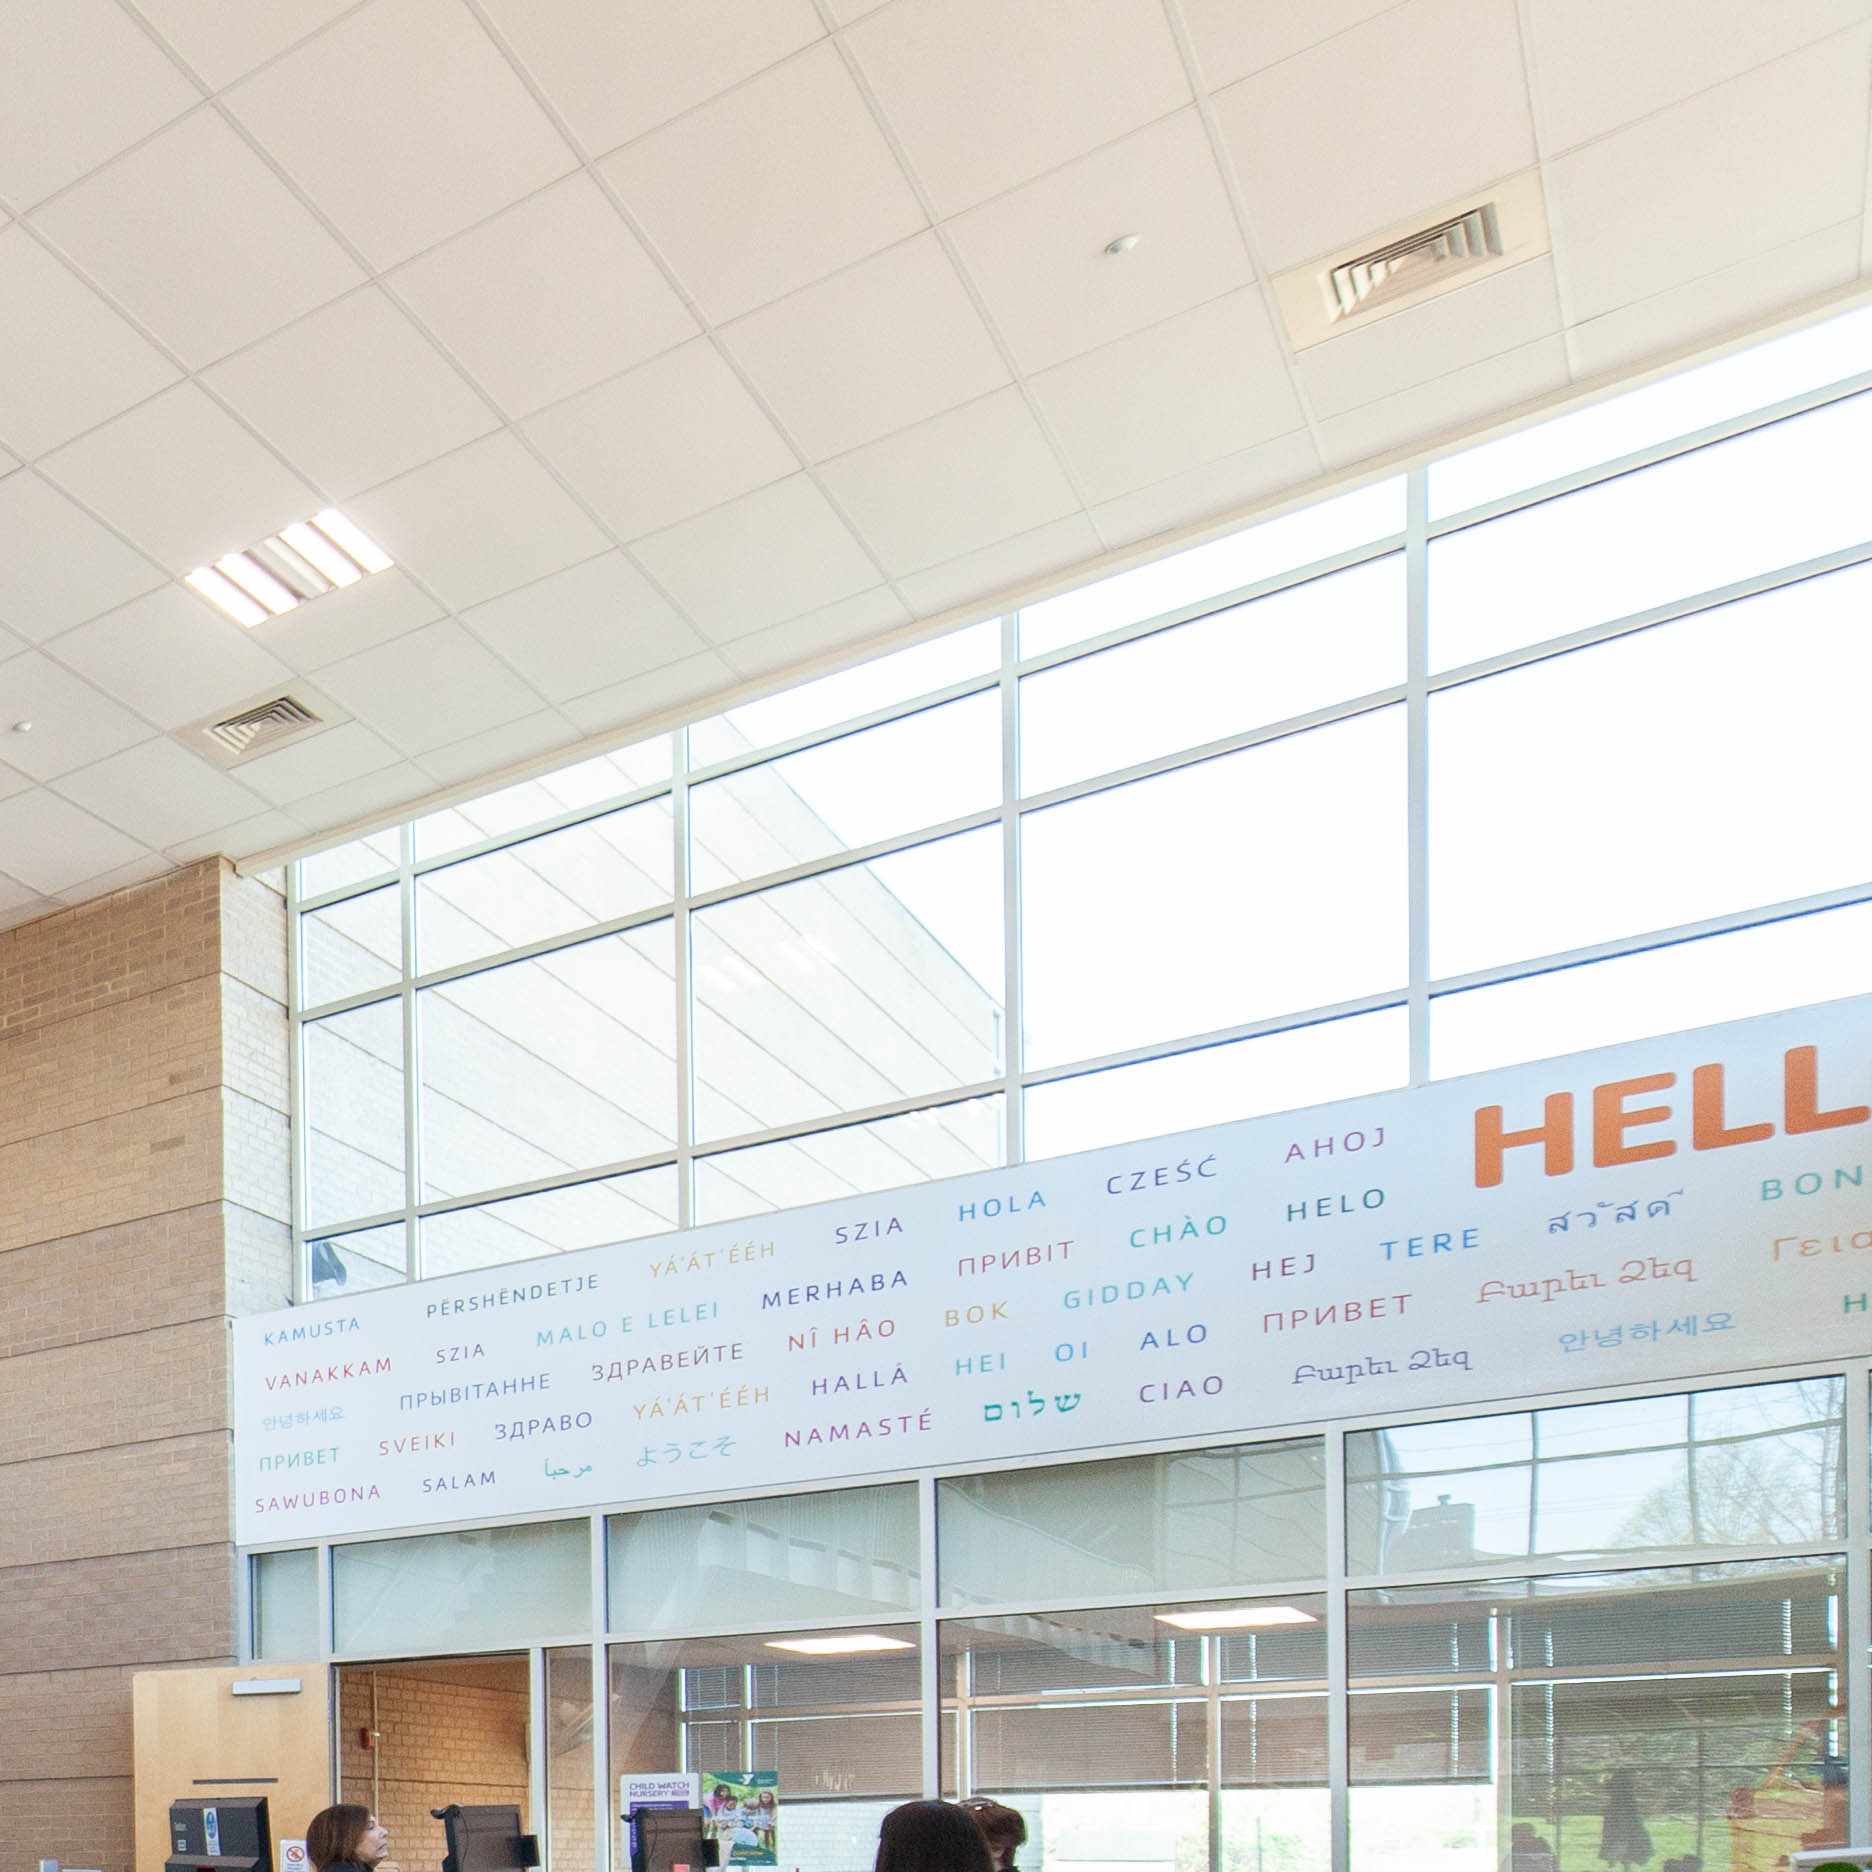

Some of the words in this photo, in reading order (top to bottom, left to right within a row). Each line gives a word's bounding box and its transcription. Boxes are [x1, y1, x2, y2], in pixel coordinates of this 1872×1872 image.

[1473, 1044, 1871, 1189] HELL
[1285, 1127, 1384, 1163] AHOJ
[1107, 1155, 1216, 1195] CZEŚĆ
[1762, 1165, 1863, 1201] BON
[959, 1191, 1045, 1222] HOLA
[1288, 1189, 1384, 1222] HELO
[835, 1217, 903, 1244] SZIA
[1130, 1215, 1227, 1248] CHÀO
[1379, 1228, 1478, 1260] TERE
[958, 1241, 1074, 1276] ПРИВІТ
[1252, 1254, 1314, 1281] HEJ
[426, 1273, 600, 1319] PËRSHËNDETJE
[762, 1270, 907, 1309] MERHABA
[1064, 1272, 1193, 1309] GIDDAY
[537, 1321, 607, 1347] MALO
[622, 1316, 632, 1333] E
[648, 1302, 717, 1328] LELEI
[945, 1301, 1007, 1327] BOK
[1264, 1294, 1412, 1333] ПРИВЕТ
[264, 1317, 360, 1346] KAMUSTA
[1140, 1324, 1207, 1350] ALO
[1559, 1312, 1736, 1352] 안녕하세요
[436, 1344, 484, 1364] SZIA
[592, 1343, 742, 1382] ЗДРАВЕЙТЕ
[956, 1353, 1005, 1376] HEI
[1055, 1342, 1087, 1362] OI
[265, 1357, 391, 1390] VANAKKAM
[1139, 1376, 1223, 1403] CIAO
[400, 1373, 550, 1410] ПРЫВІТАННЕ
[984, 1390, 1081, 1422] שלום
[263, 1406, 344, 1431] 안녕하세요
[495, 1412, 592, 1440] ЗДРАВО
[785, 1408, 931, 1447] NAMASTÉ
[259, 1447, 340, 1472] ПРИВЕТ
[379, 1432, 454, 1456] SVEIKI
[636, 1436, 736, 1467] ようこそ
[423, 1471, 495, 1493] SALAM
[256, 1484, 380, 1513] SAWUBONA
[629, 1783, 656, 1791] CHILD
[657, 1781, 690, 1790] WATCH
